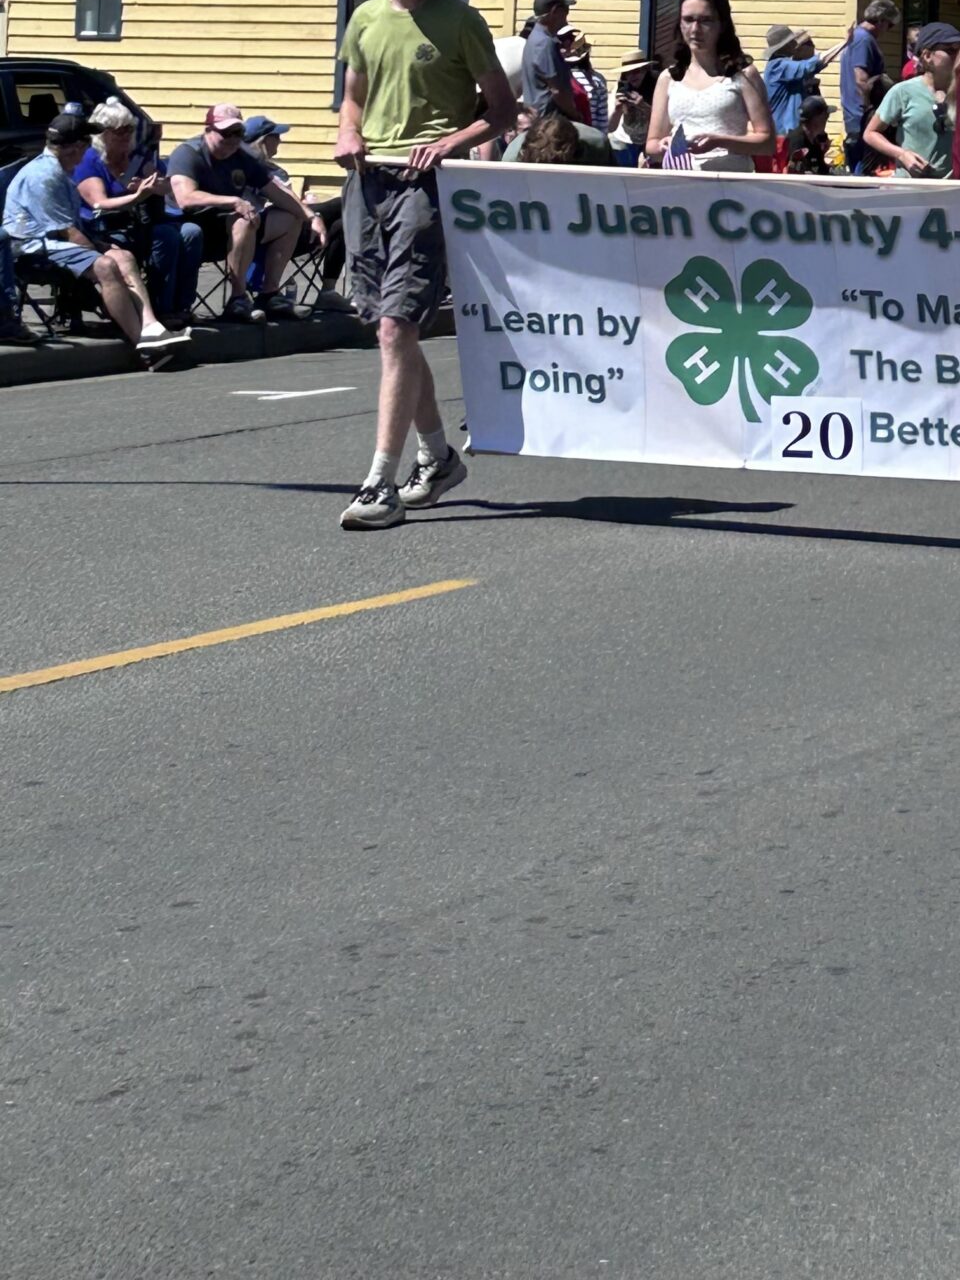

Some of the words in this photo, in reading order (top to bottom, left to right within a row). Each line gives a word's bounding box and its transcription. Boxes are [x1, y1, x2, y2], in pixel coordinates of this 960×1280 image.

[451, 189, 550, 231] San
[567, 193, 694, 237] Juan
[708, 199, 901, 256] County
[461, 303, 584, 337] “Learn
[597, 307, 641, 346] by
[842, 289, 904, 320] “To
[500, 361, 624, 404] Doing”
[850, 349, 922, 384] The
[781, 410, 854, 460] 20
